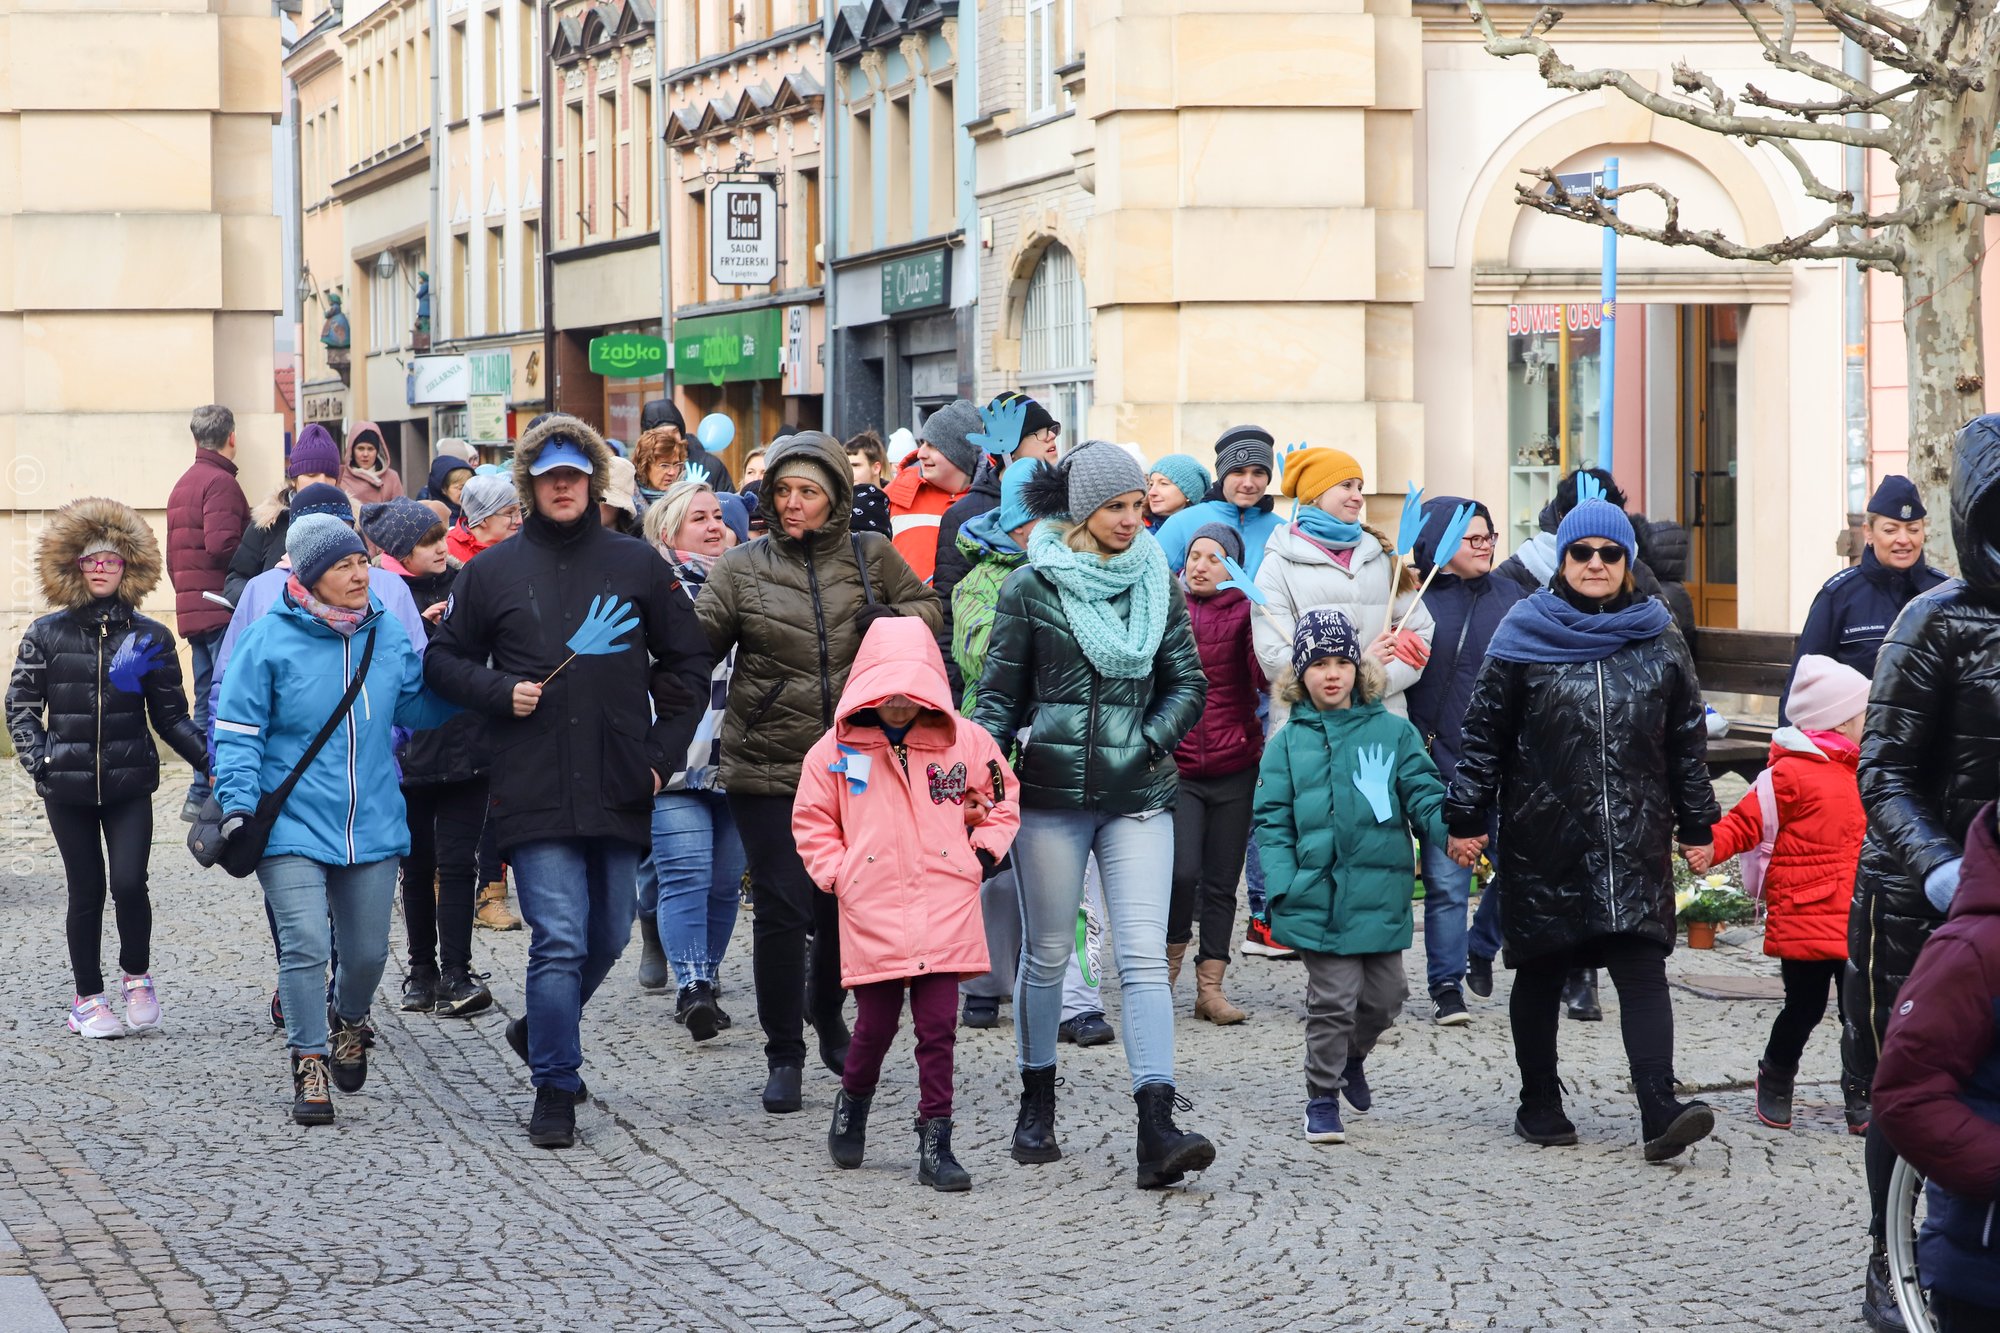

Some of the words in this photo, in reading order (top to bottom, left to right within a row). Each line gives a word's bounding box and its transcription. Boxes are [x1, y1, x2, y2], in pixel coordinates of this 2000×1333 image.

[731, 194, 758, 215] Carlo
[731, 217, 758, 238] Biani
[731, 244, 758, 253] SALON
[720, 257, 769, 266] FRYZJERSKI
[600, 342, 661, 360] żabka
[703, 327, 740, 367] żabka
[934, 778, 961, 790] BEST
